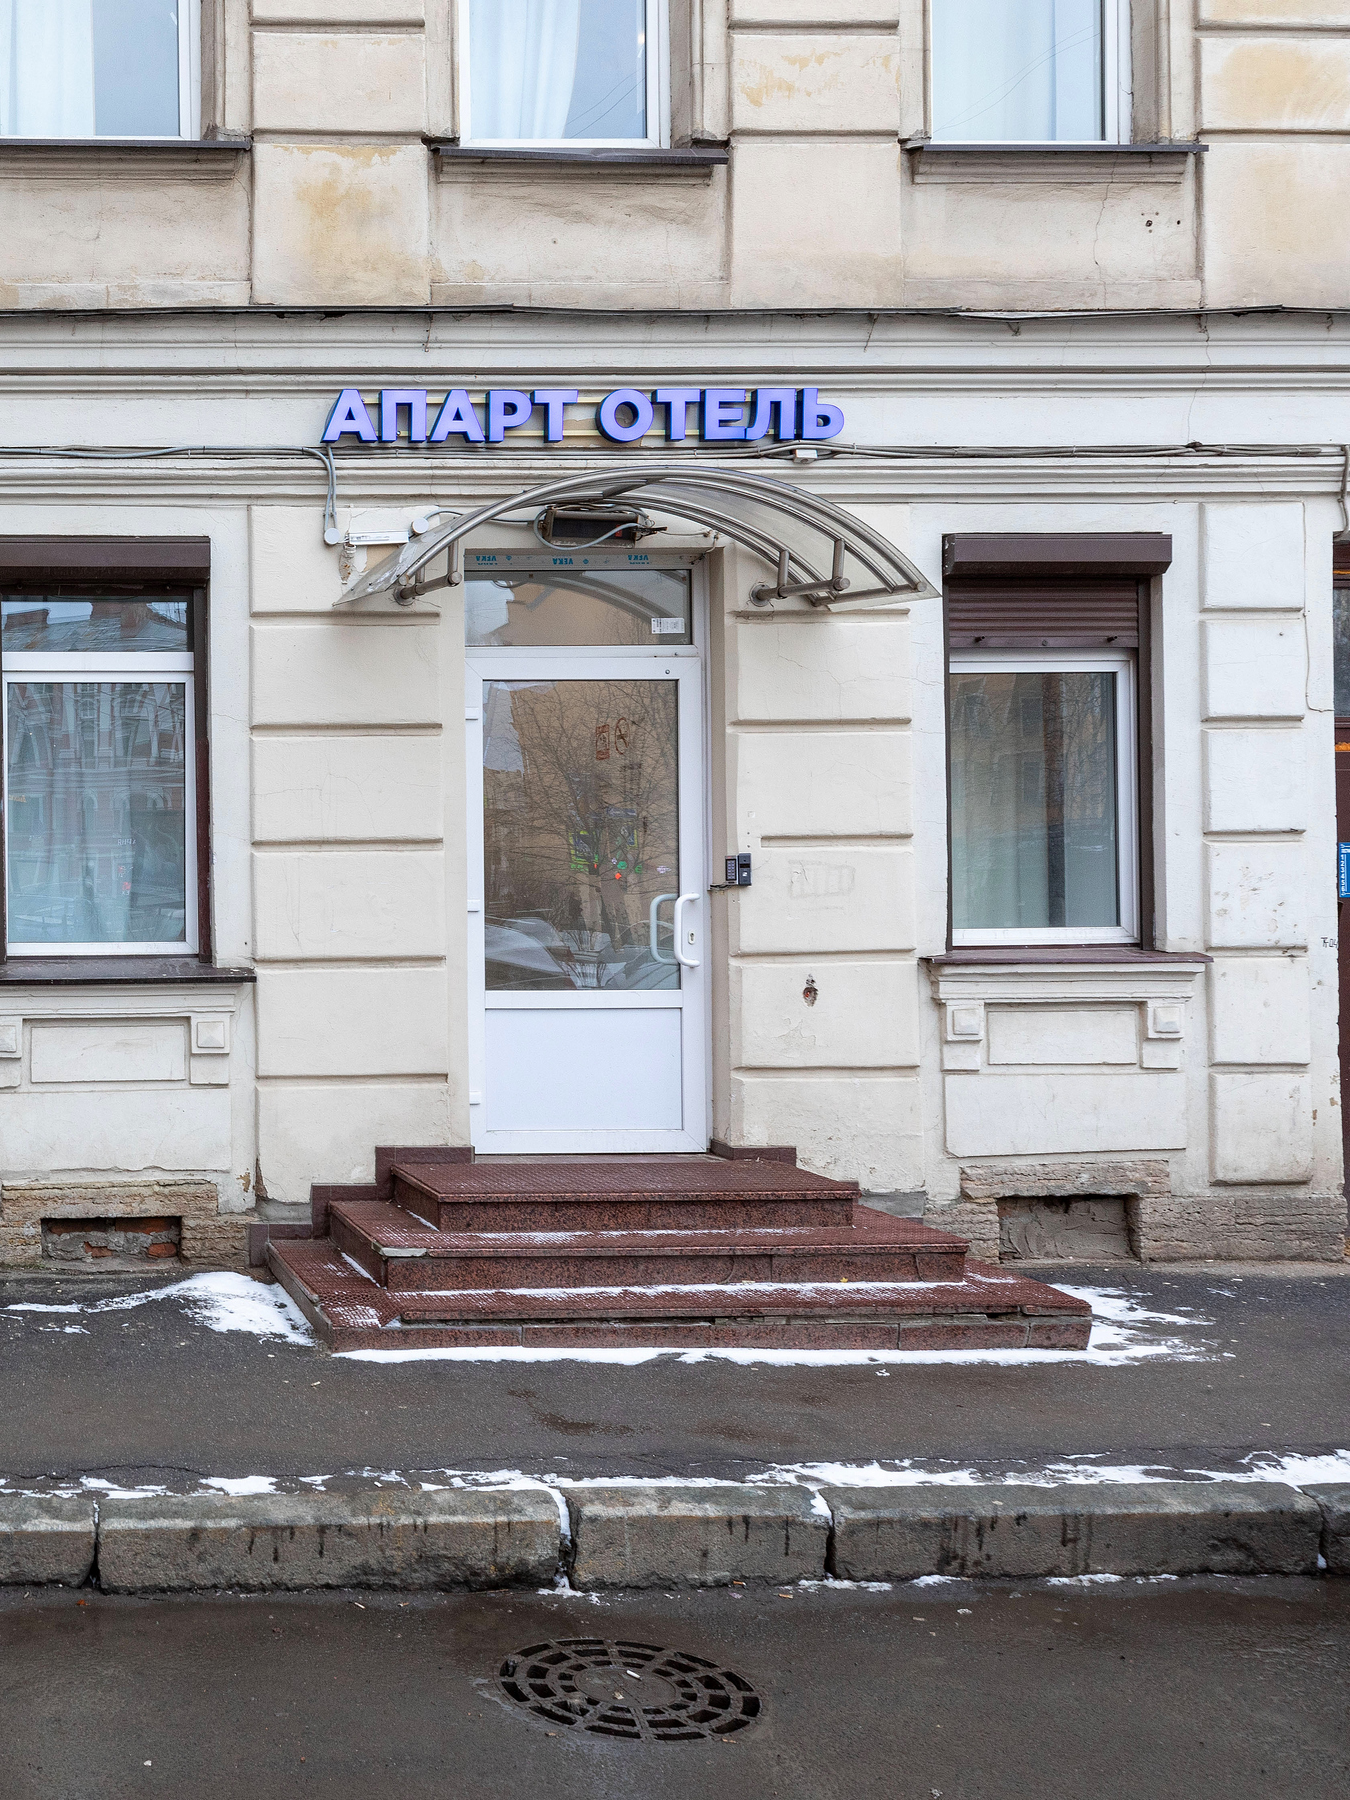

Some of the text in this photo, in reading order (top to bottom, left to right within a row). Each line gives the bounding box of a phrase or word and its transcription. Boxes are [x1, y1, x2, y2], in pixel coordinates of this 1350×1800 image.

[321, 387, 845, 443] АПАРТ ОТЕЛЬ
[552, 557, 574, 565] VEKA
